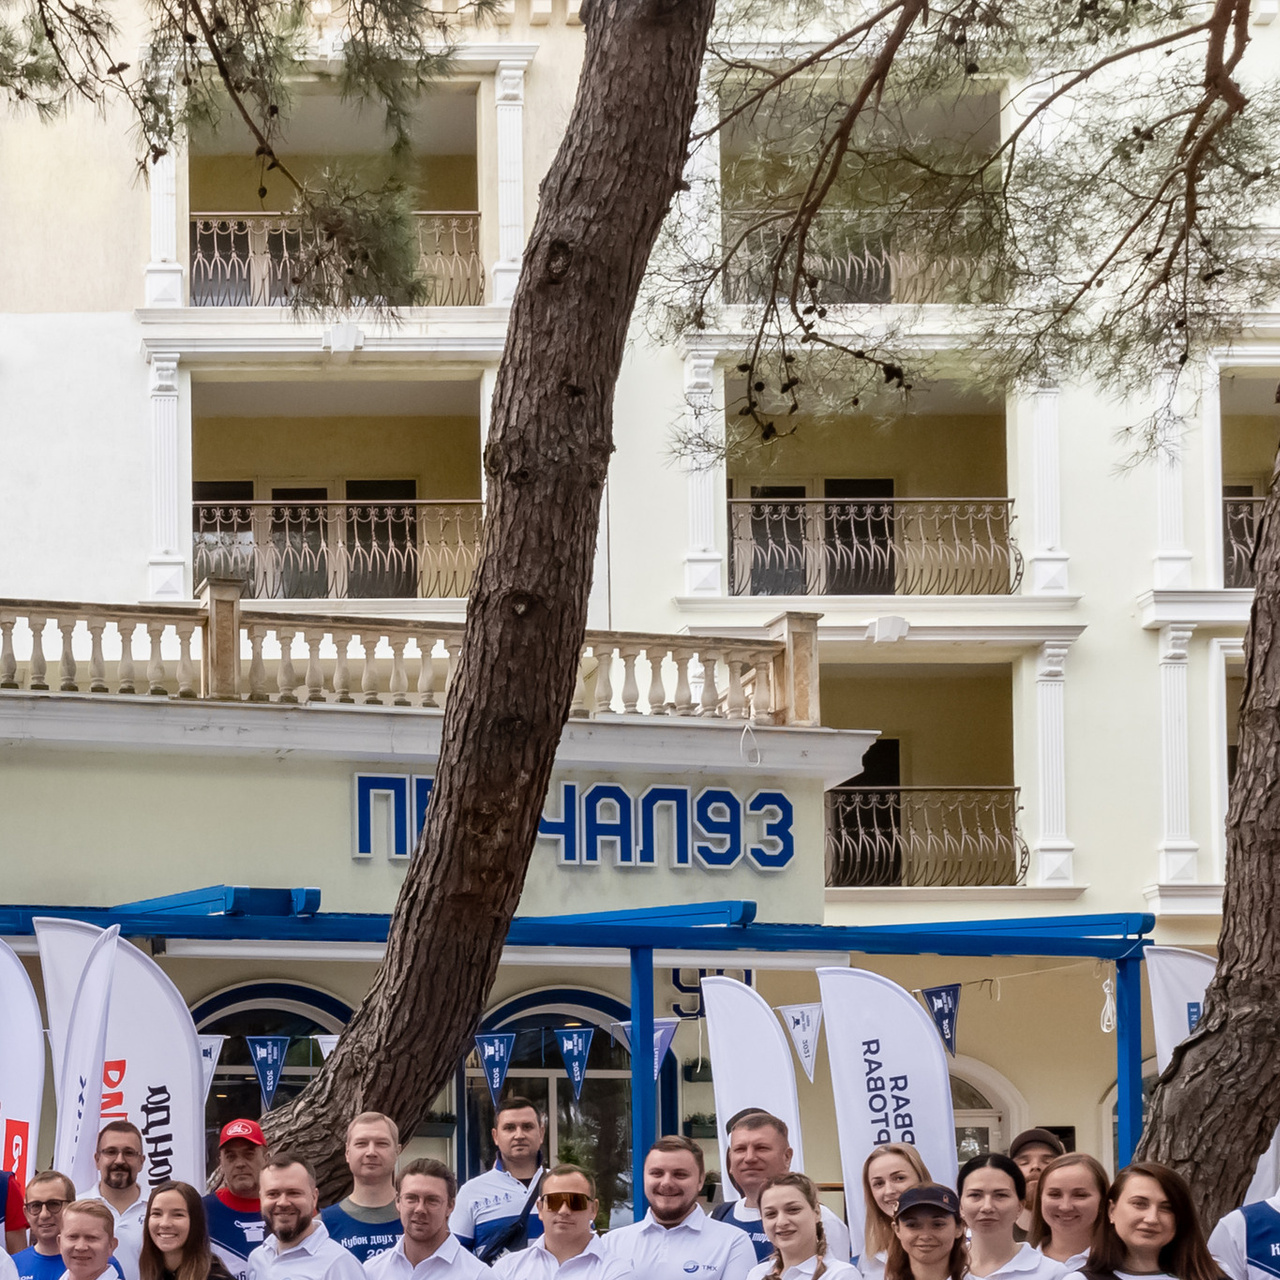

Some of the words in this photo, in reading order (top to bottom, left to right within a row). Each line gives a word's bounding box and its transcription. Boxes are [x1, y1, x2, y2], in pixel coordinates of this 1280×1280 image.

[353, 772, 796, 872] ПЧАЛ93
[340, 1237, 368, 1248] Кубок
[369, 1234, 394, 1246] двух
